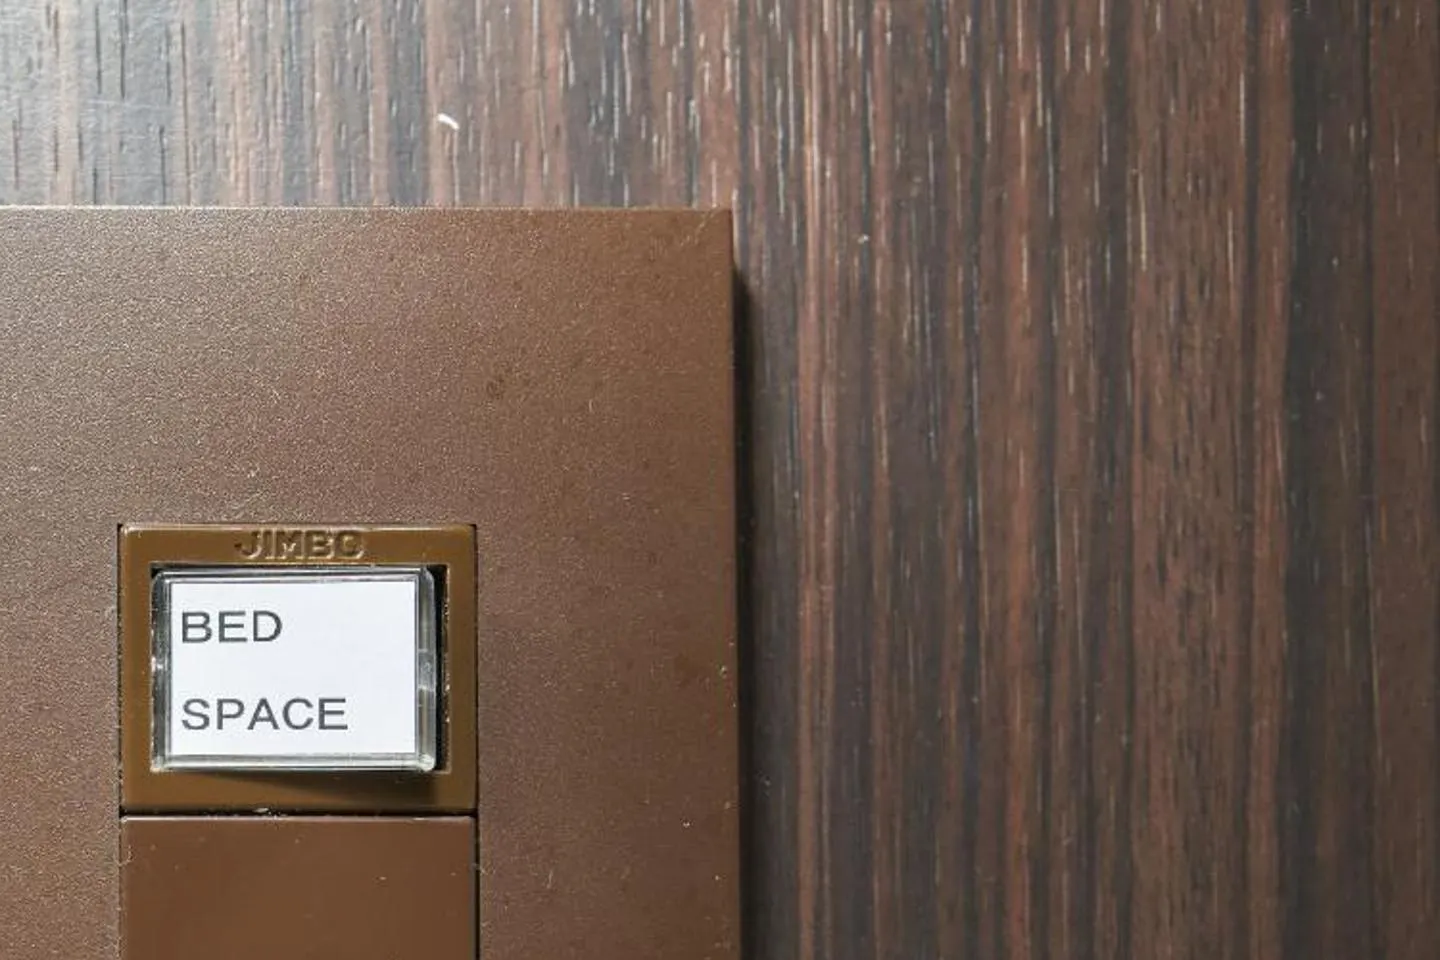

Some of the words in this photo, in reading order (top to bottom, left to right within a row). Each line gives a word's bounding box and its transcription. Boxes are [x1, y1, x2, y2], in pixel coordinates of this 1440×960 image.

[234, 530, 366, 560] JIMBO
[181, 610, 283, 643] BED
[181, 697, 349, 731] SPACE
